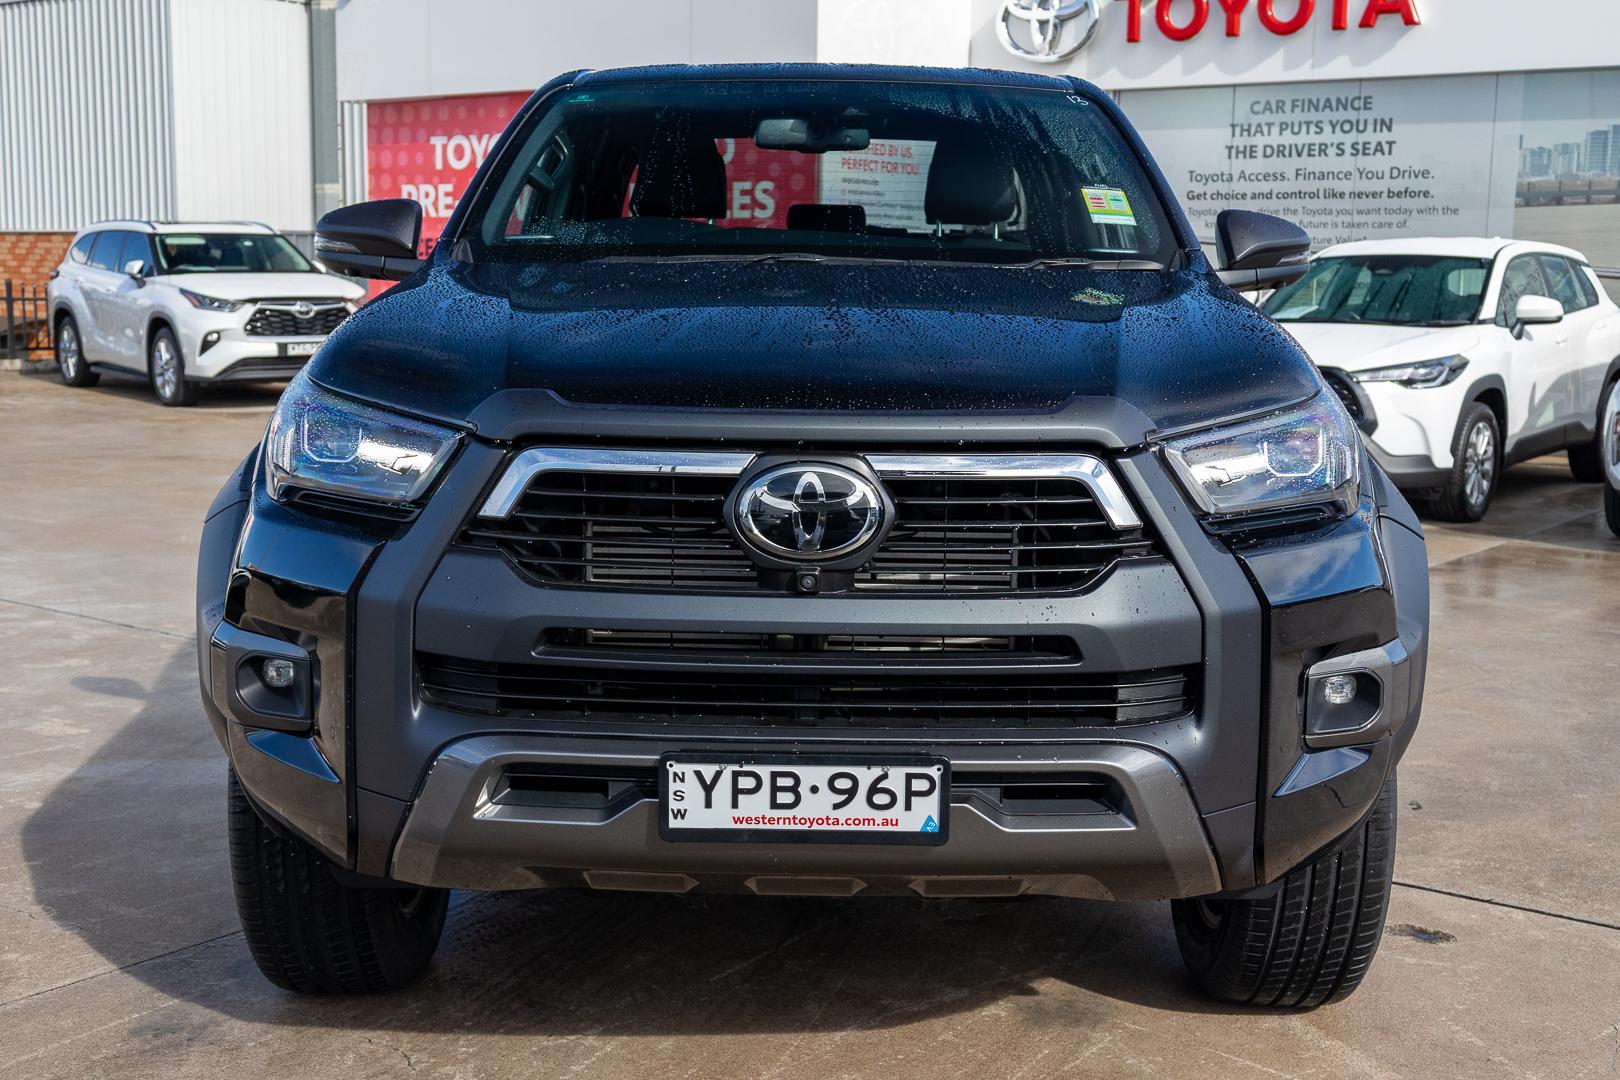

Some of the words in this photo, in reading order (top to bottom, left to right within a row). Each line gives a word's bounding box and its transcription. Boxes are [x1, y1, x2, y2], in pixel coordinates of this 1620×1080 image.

[1250, 100, 1286, 115] CAR
[1290, 96, 1373, 114] FINANCE
[1229, 122, 1274, 138] THAT
[1279, 120, 1324, 136] PUTS
[1328, 118, 1368, 135] YOU
[1373, 117, 1393, 133] IN
[429, 133, 502, 170] TOY
[1225, 144, 1258, 160] THE
[1263, 142, 1346, 159] DRIVER’S
[1350, 140, 1396, 157] SEAT
[841, 158, 879, 173] PERFECT
[881, 160, 899, 174] FOR
[1188, 170, 1234, 186] Toyota
[1237, 169, 1290, 182] Access.
[1295, 168, 1353, 181] Finance
[1357, 167, 1384, 180] You
[1390, 165, 1435, 179] Drive.
[1186, 190, 1208, 201] Get
[1210, 189, 1247, 201] choice
[1250, 189, 1273, 200] and
[1275, 188, 1320, 200] control
[1323, 187, 1346, 199] like
[1349, 189, 1384, 199] never
[1387, 187, 1434, 199] before.
[1188, 207, 1217, 218] Toyota
[1283, 206, 1298, 216] the
[1301, 206, 1333, 218] Toyota
[1336, 207, 1353, 218] you
[1356, 206, 1381, 216] want
[1384, 205, 1414, 217] today
[1416, 205, 1438, 216] with
[1441, 205, 1460, 216] the
[1331, 219, 1339, 229] is
[1342, 219, 1369, 229] taken
[1372, 220, 1394, 229] care
[732, 814, 899, 829] westerntoyota.com.au
